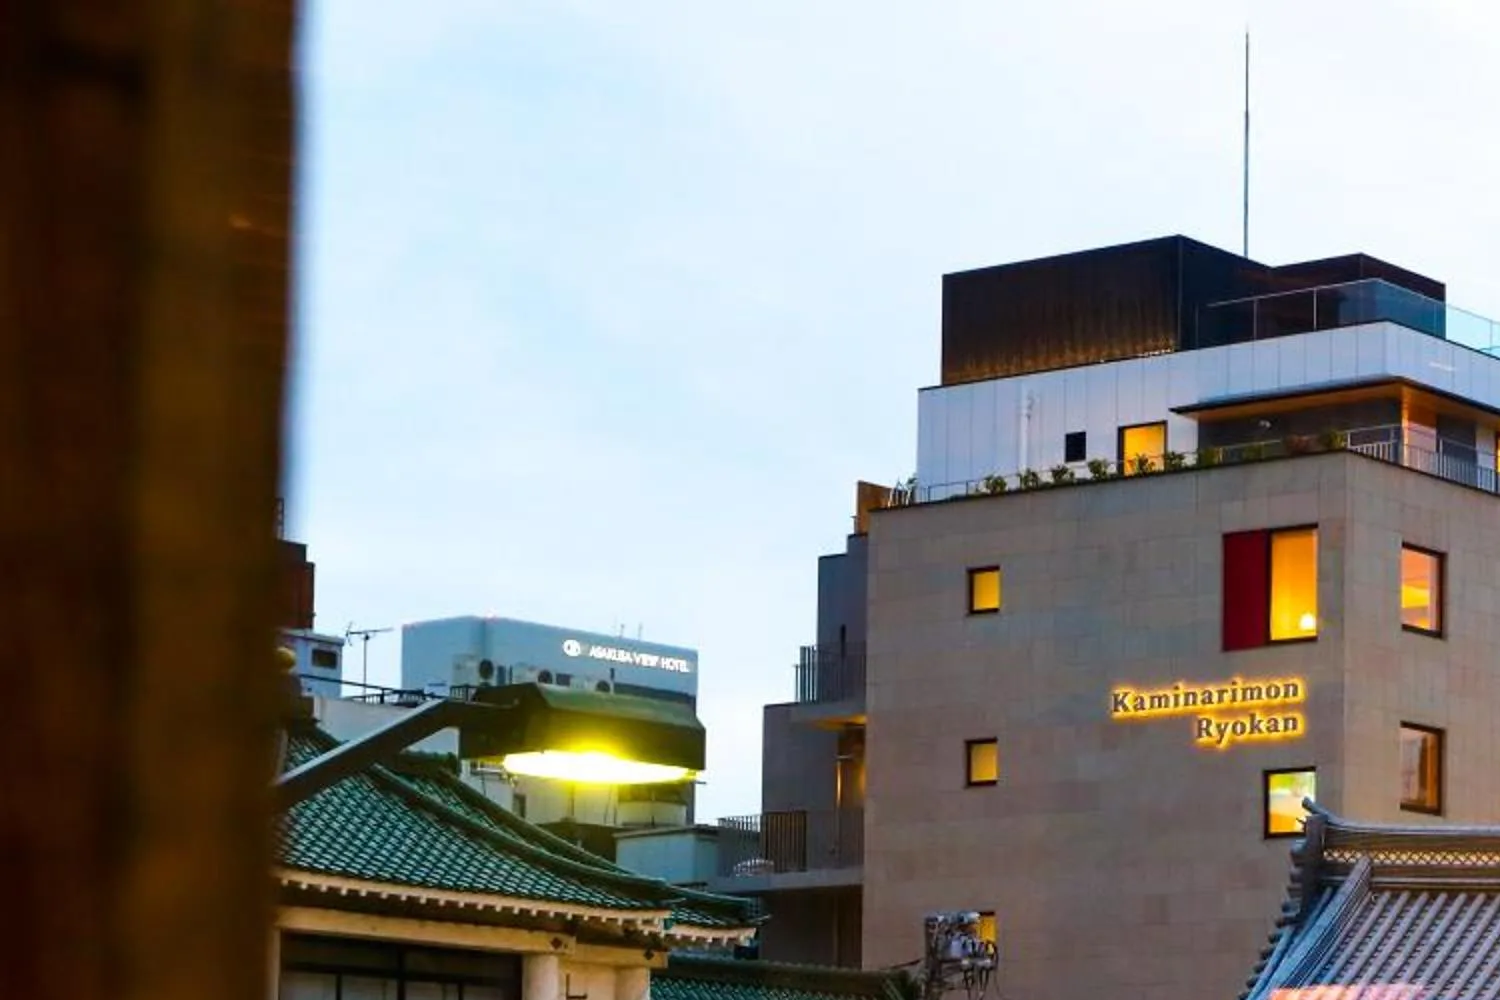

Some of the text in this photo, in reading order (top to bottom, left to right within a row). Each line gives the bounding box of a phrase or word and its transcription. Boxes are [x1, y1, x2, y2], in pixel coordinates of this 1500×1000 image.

[633, 651, 659, 667] VIEW
[661, 656, 690, 673] HOTEL
[1110, 679, 1301, 715] Kaminarimon
[1195, 712, 1301, 746] Ryokan
